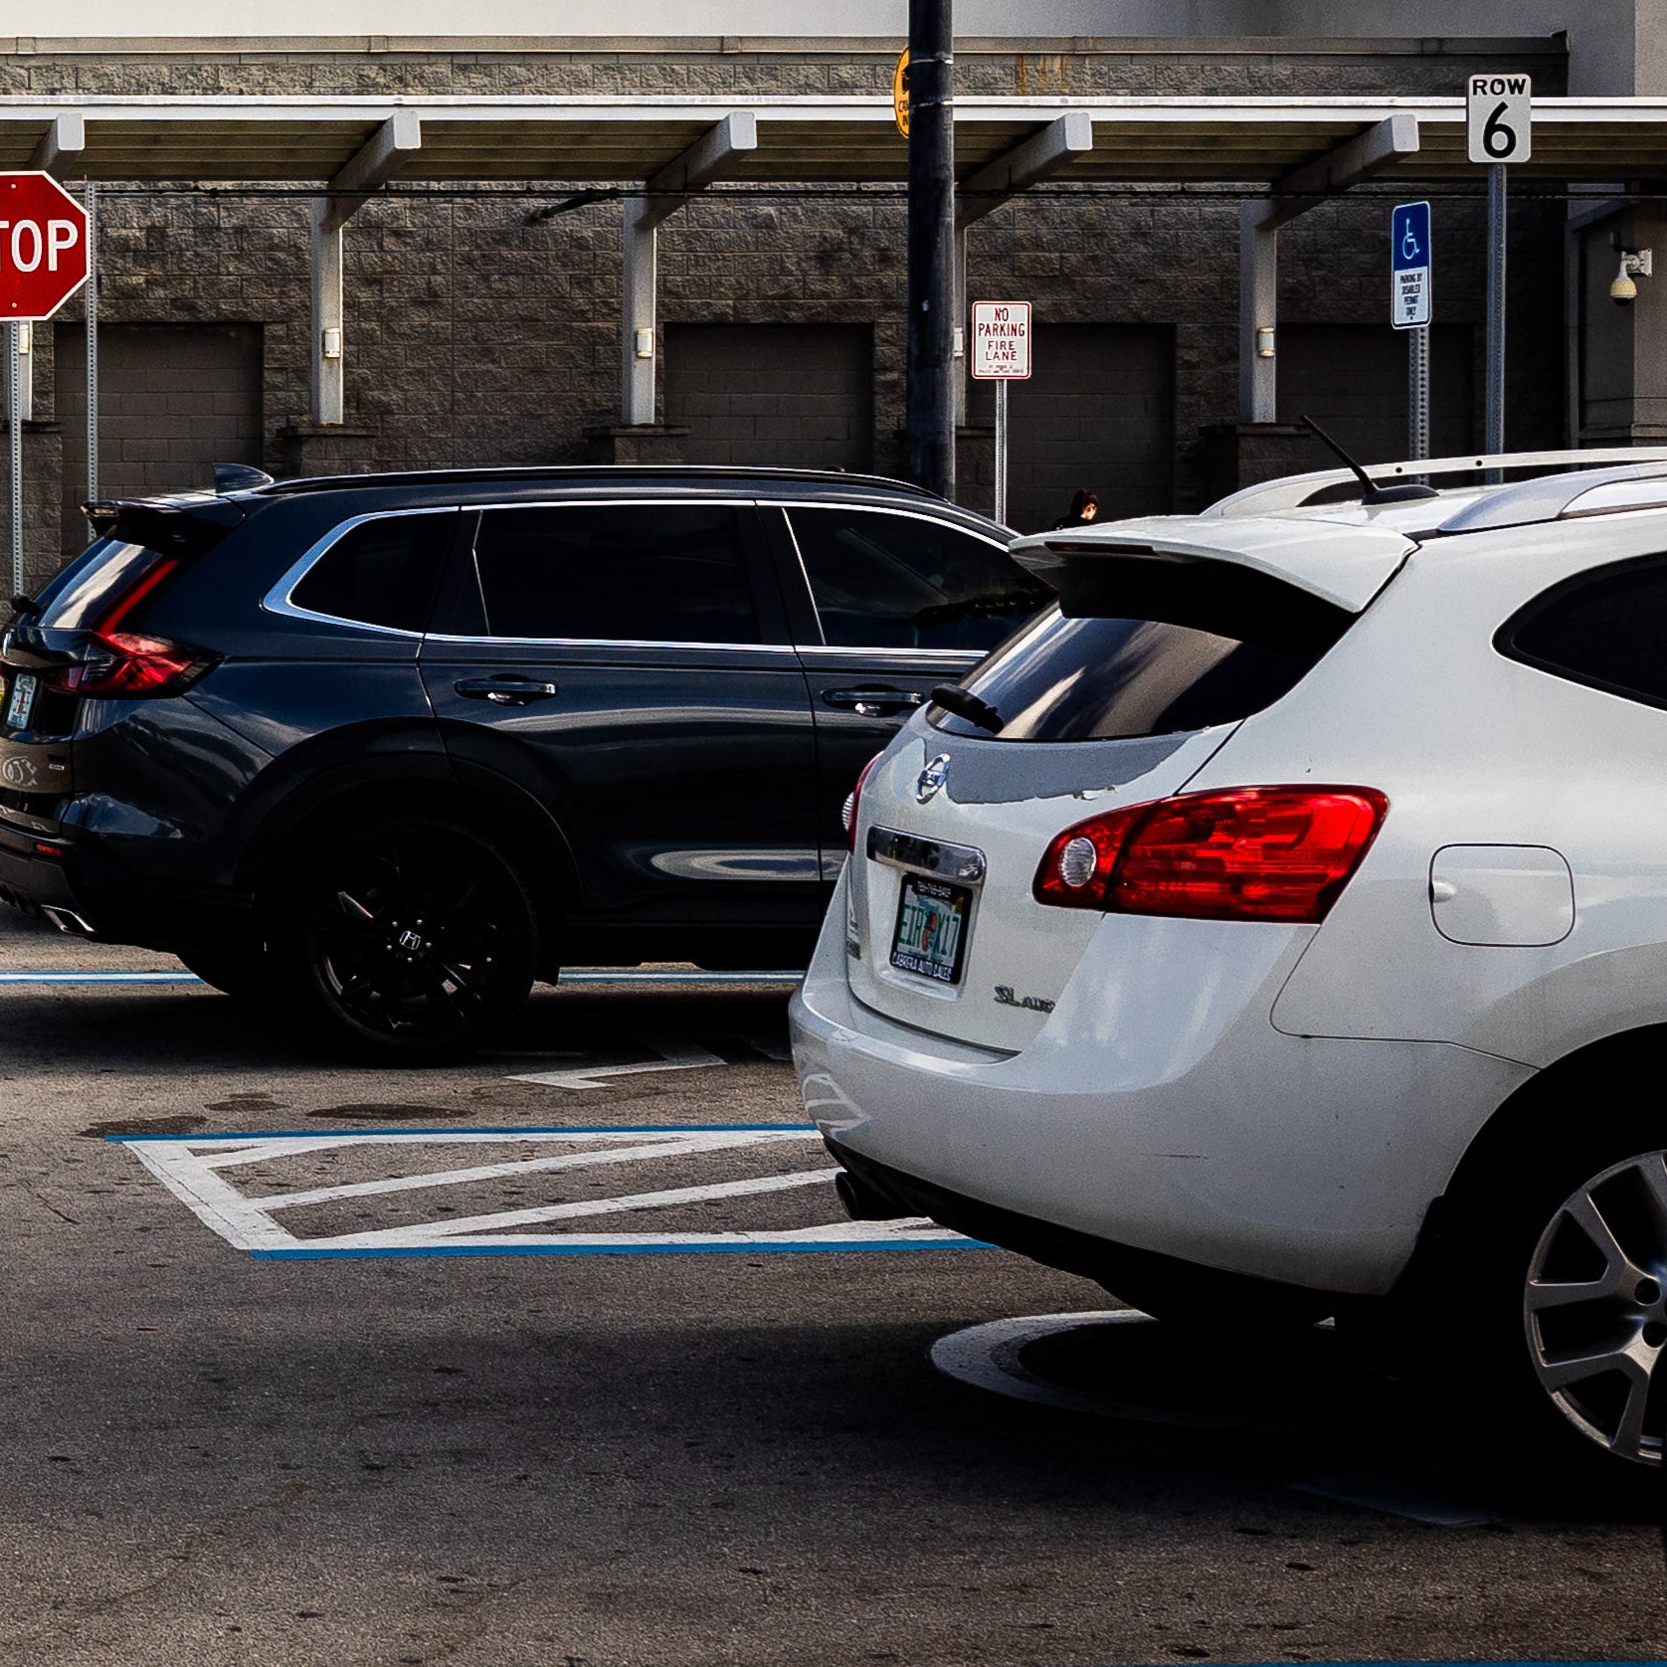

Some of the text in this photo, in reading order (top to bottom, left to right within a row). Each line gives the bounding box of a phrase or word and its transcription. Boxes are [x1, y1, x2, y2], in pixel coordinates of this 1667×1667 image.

[1472, 78, 1527, 96] ROW
[1482, 101, 1517, 159] 6
[994, 308, 1009, 322] NO
[978, 323, 1025, 337] PARKING
[988, 340, 1016, 350] FIRE
[985, 351, 1018, 361] LANE
[917, 957, 933, 975] AUTO
[993, 984, 1020, 1007] SL
